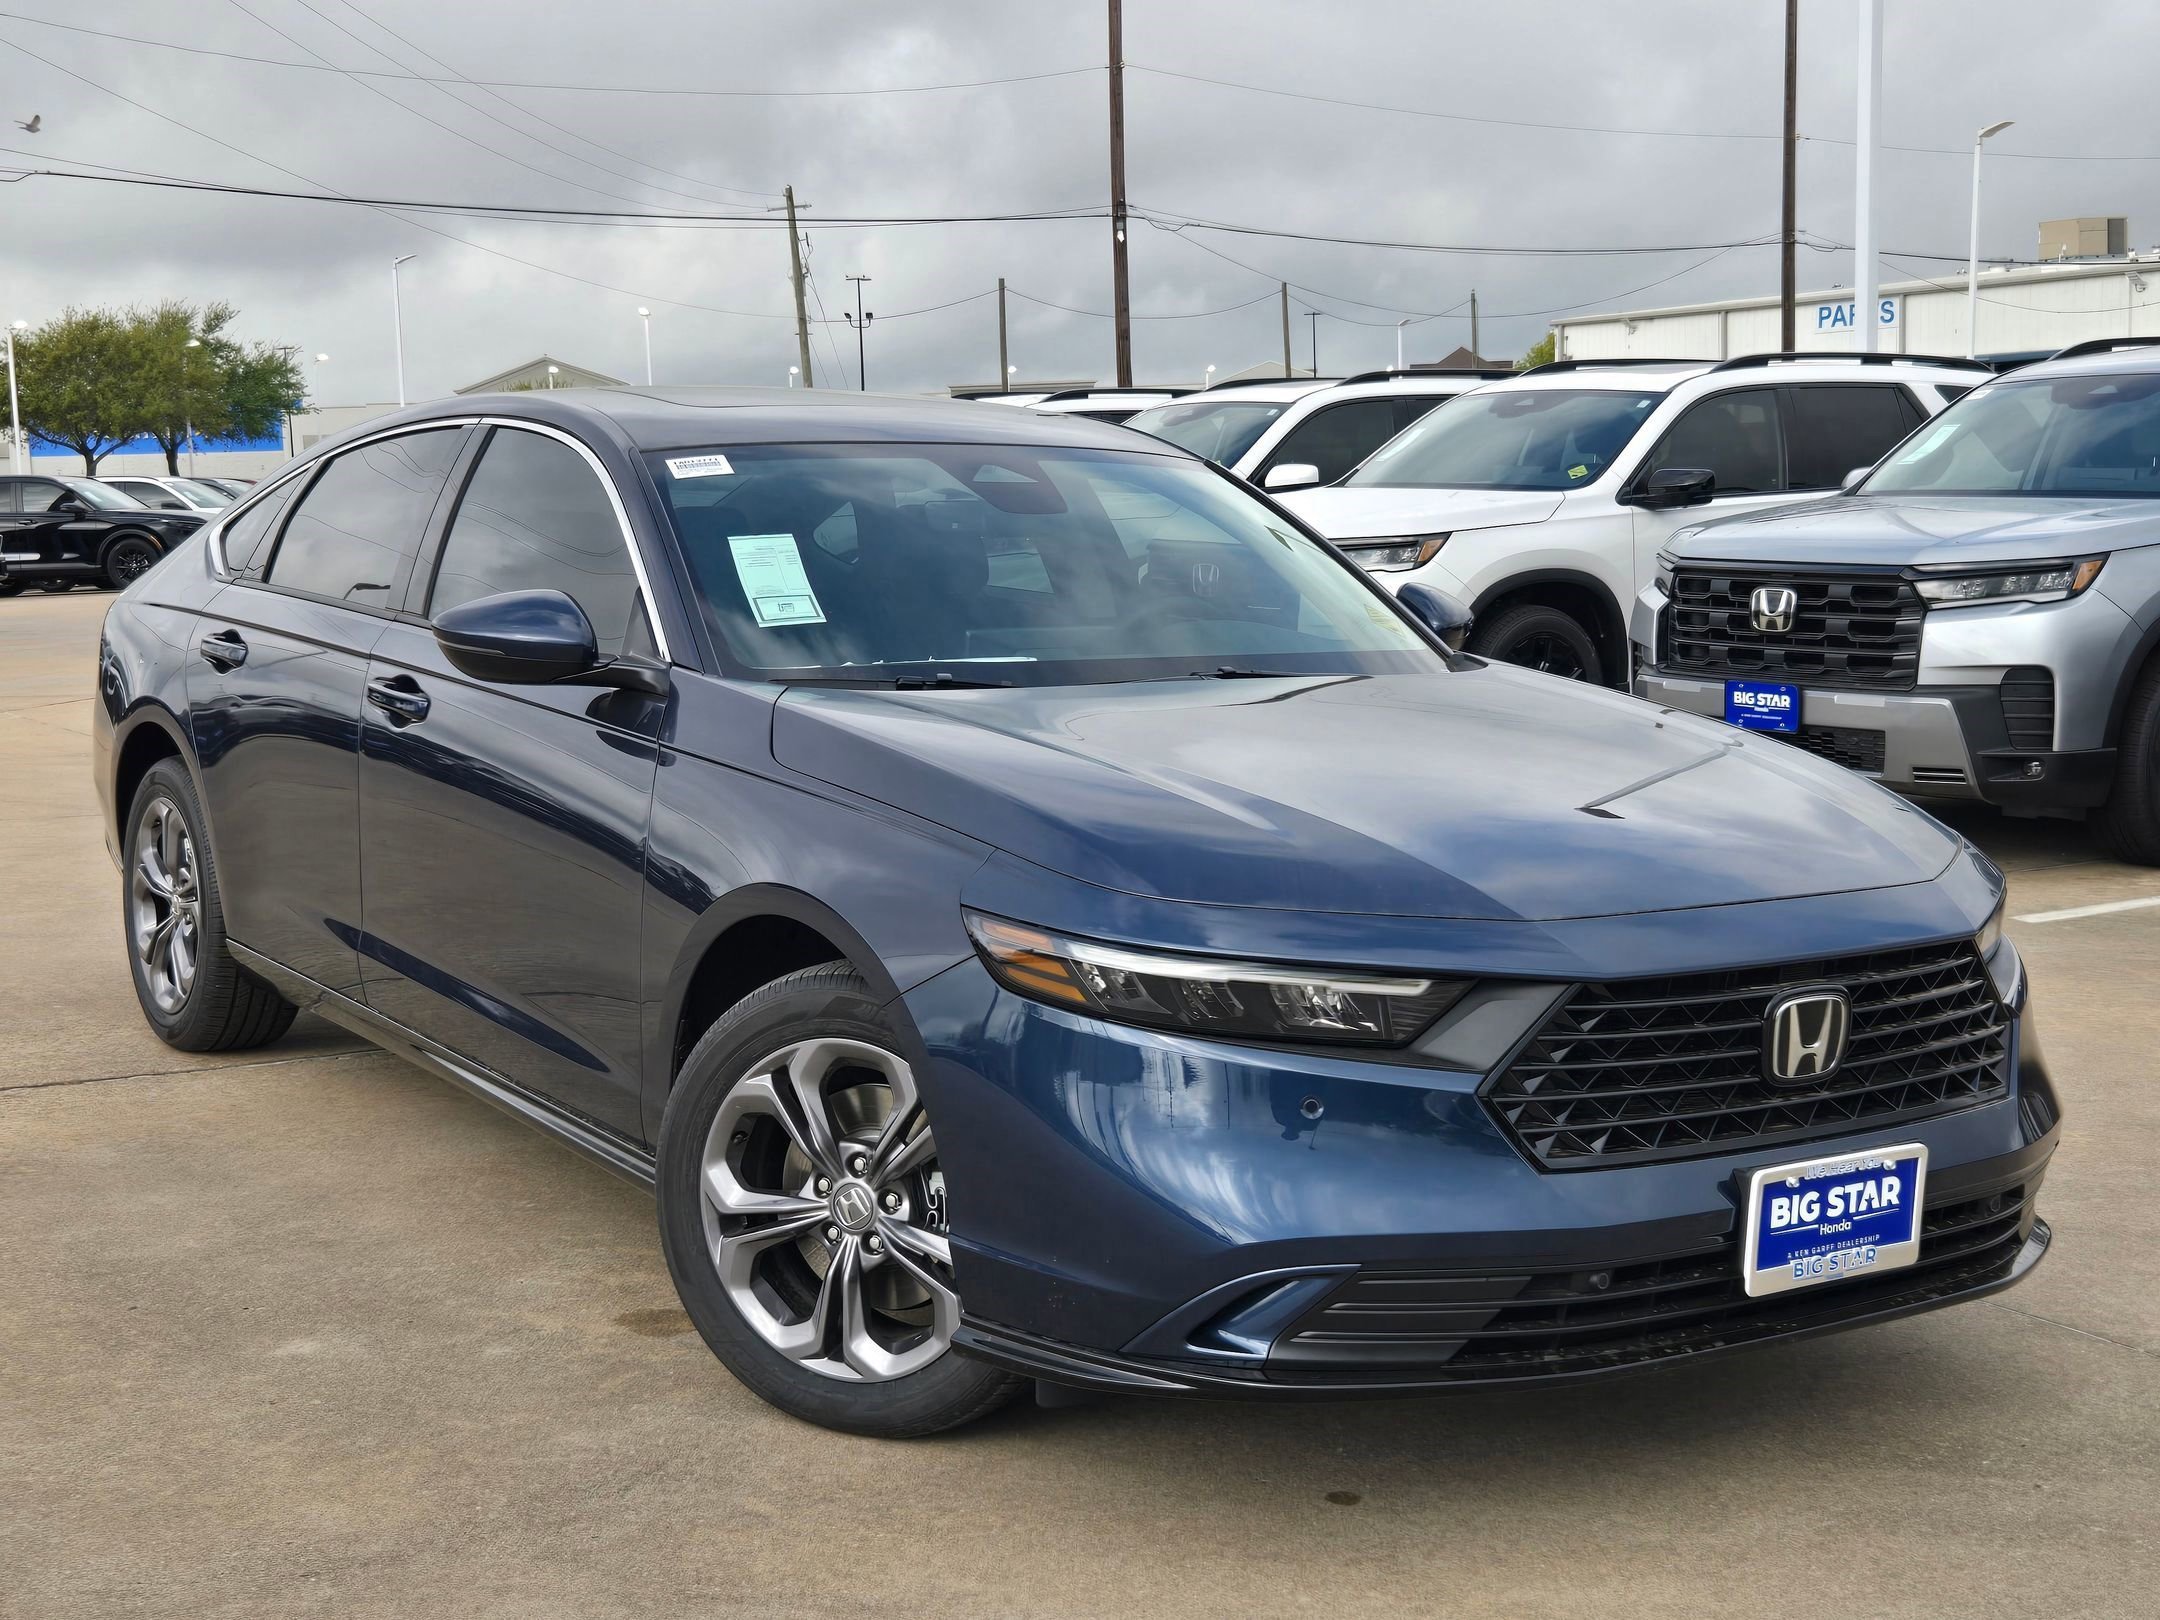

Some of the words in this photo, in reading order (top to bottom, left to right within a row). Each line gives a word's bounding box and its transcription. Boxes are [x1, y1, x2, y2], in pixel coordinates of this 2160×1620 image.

[1818, 300, 1895, 329] PAS
[1733, 691, 1755, 704] BIG
[1757, 693, 1791, 708] STAR
[1770, 1191, 1820, 1229] BIG
[1826, 1176, 1901, 1218] STAR
[1820, 1219, 1852, 1235] Honda
[1794, 1248, 1809, 1257] KEN
[1811, 1243, 1835, 1254] GARFF
[1837, 1234, 1880, 1249] DEALERSHIP
[1792, 1256, 1823, 1279] BIG
[1828, 1246, 1878, 1272] STAR
